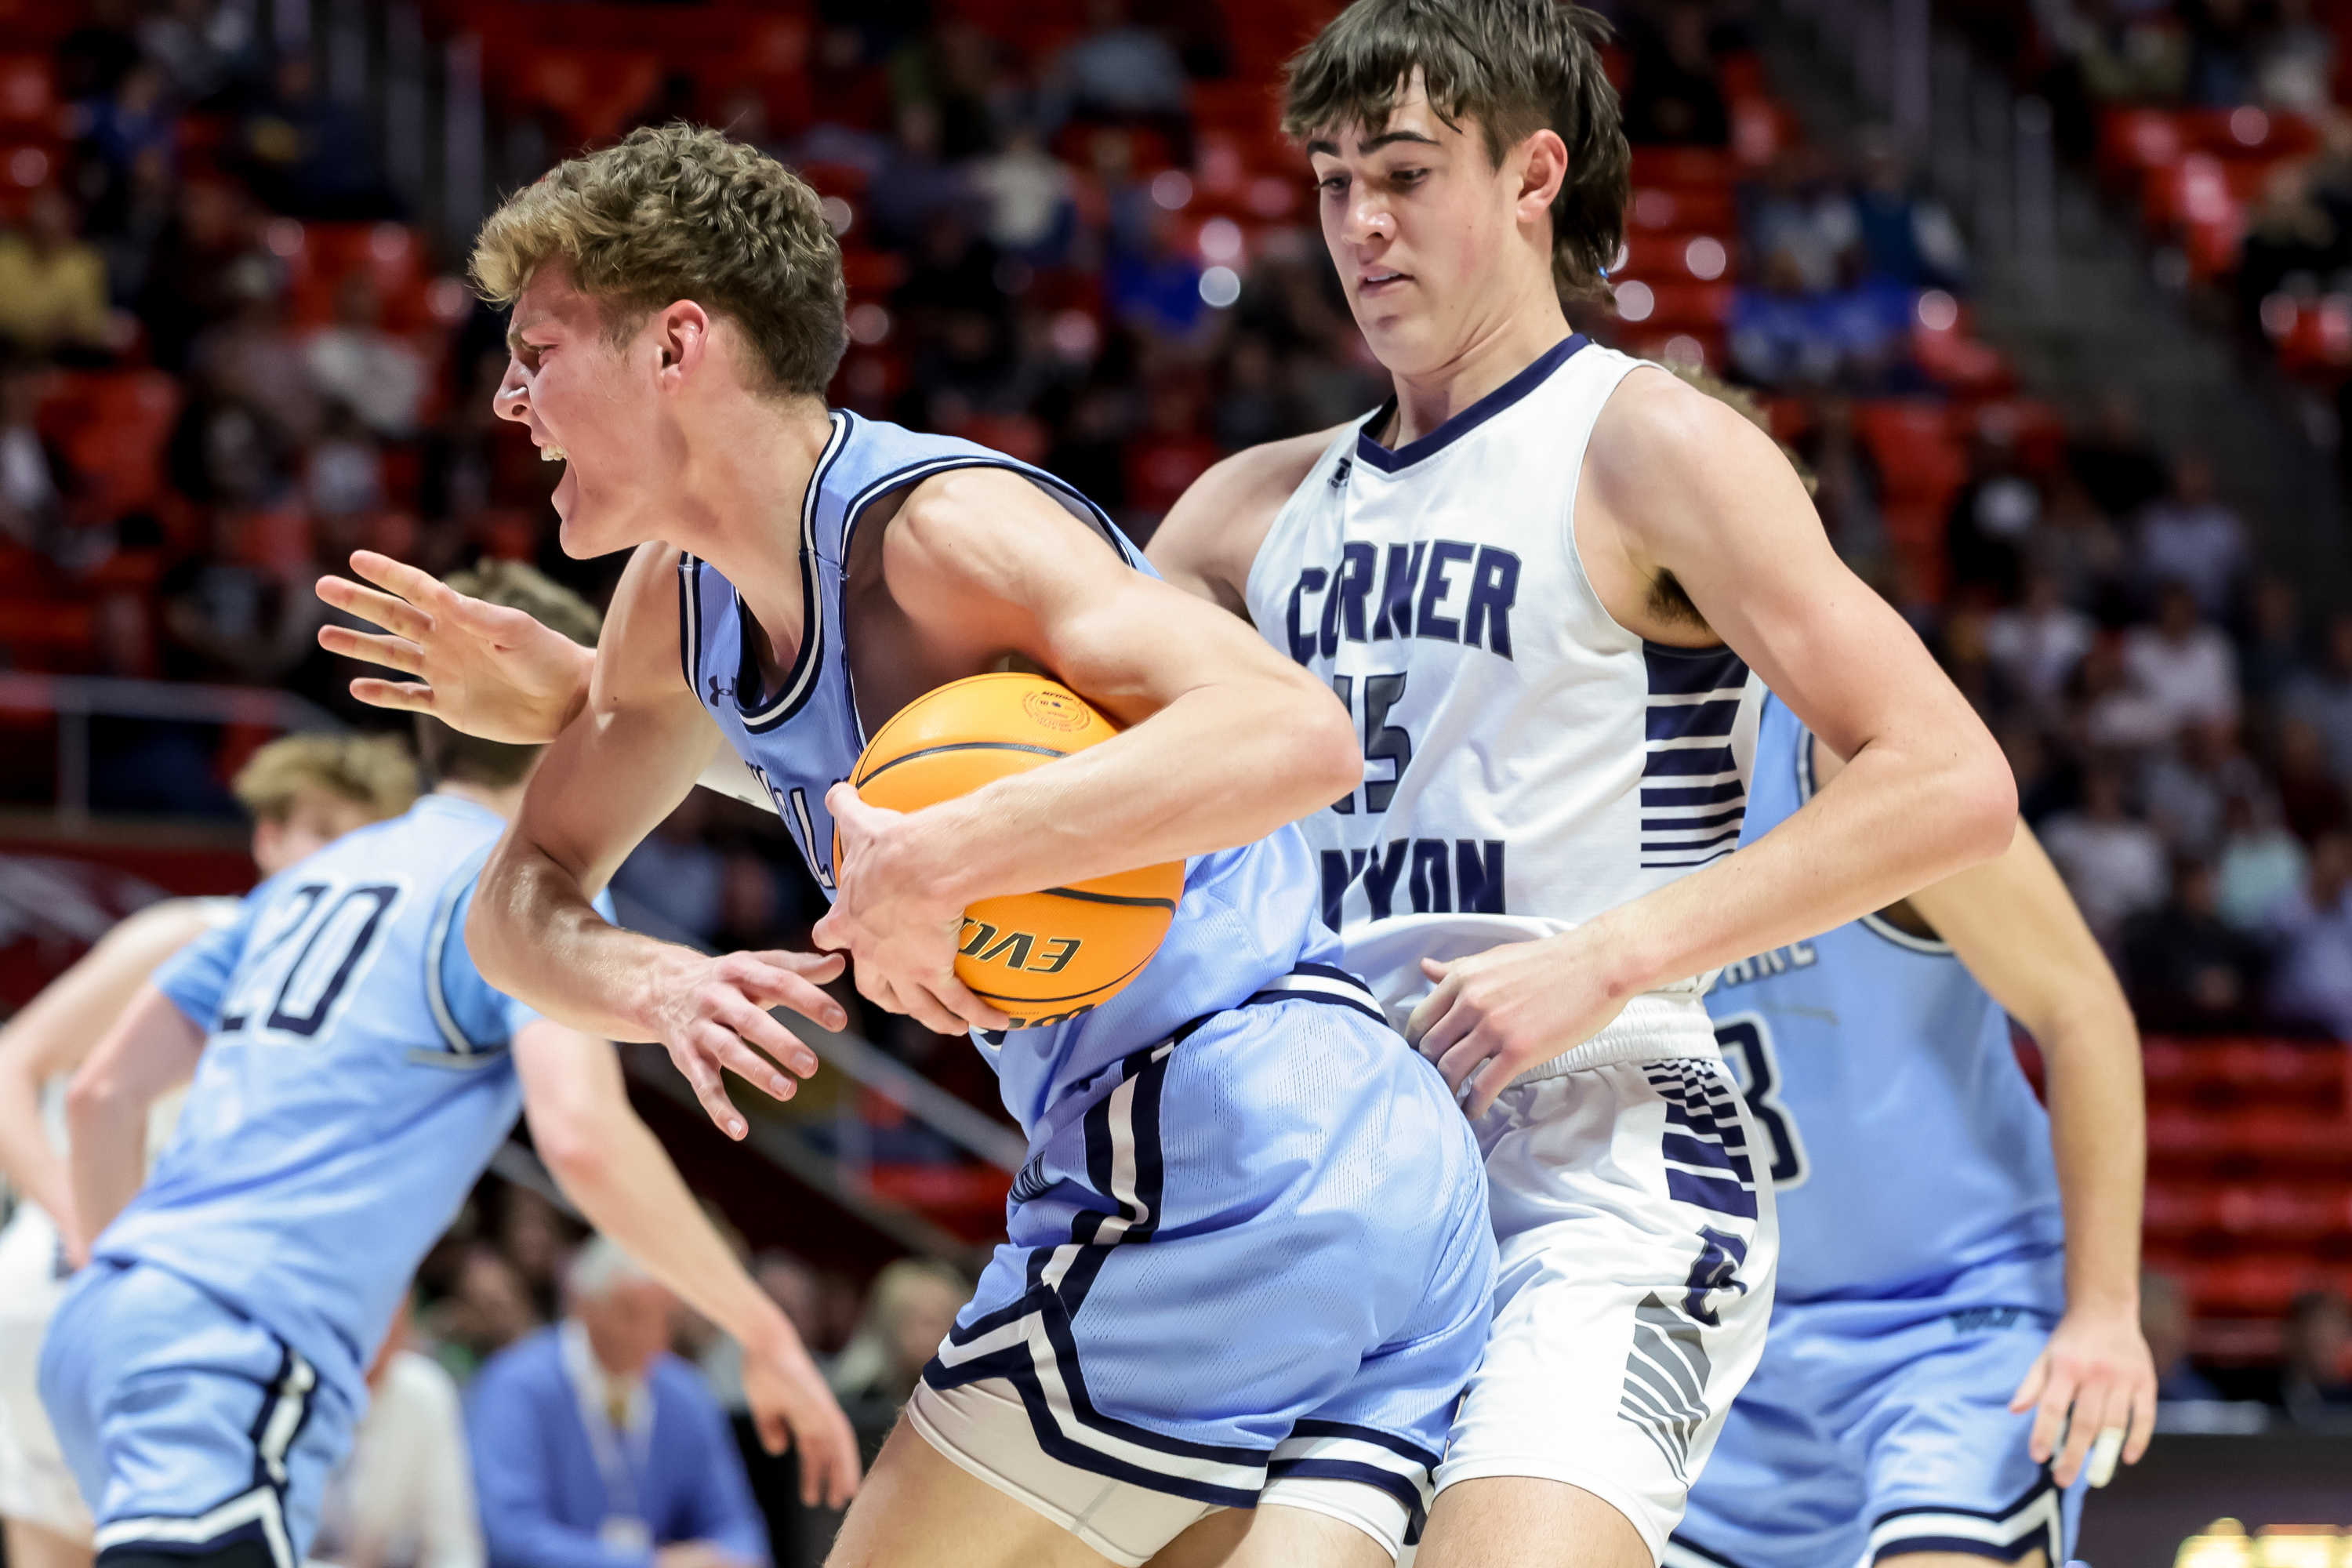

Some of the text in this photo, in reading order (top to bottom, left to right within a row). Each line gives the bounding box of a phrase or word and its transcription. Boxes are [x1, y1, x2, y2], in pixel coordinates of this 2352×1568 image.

[1287, 539, 1523, 667] CORNER
[1320, 837, 1505, 934] NYON
[218, 881, 403, 1038] 20
